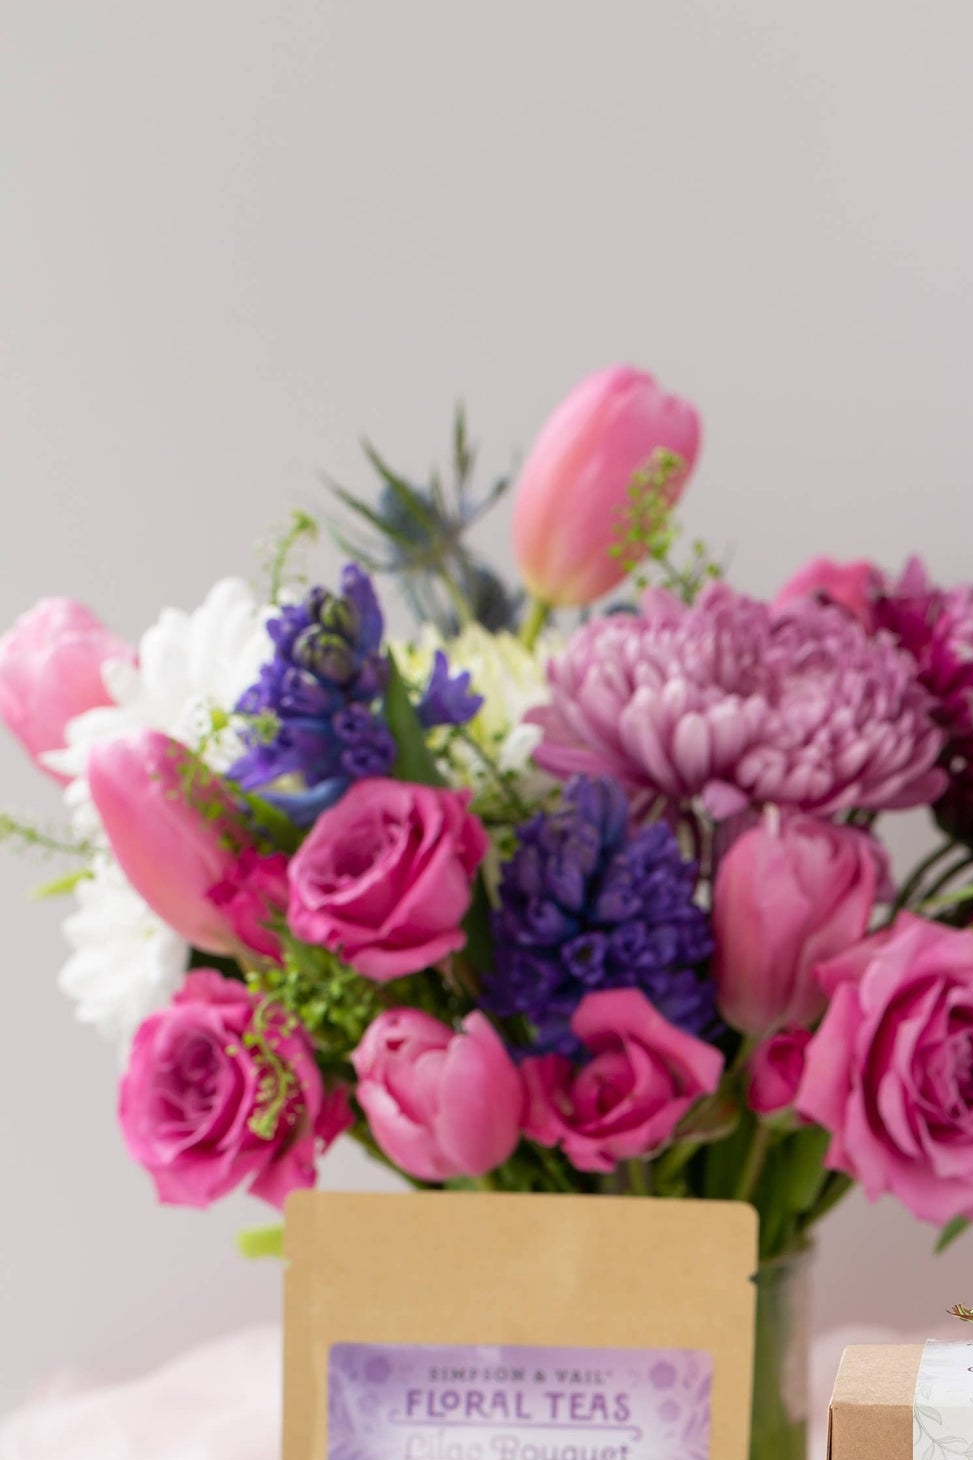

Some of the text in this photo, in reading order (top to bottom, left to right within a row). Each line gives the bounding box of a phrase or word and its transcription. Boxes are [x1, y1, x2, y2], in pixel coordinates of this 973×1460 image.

[429, 1366, 525, 1382] SIMPSON
[533, 1369, 546, 1382] &
[406, 1388, 630, 1422] FLORAL TEAS
